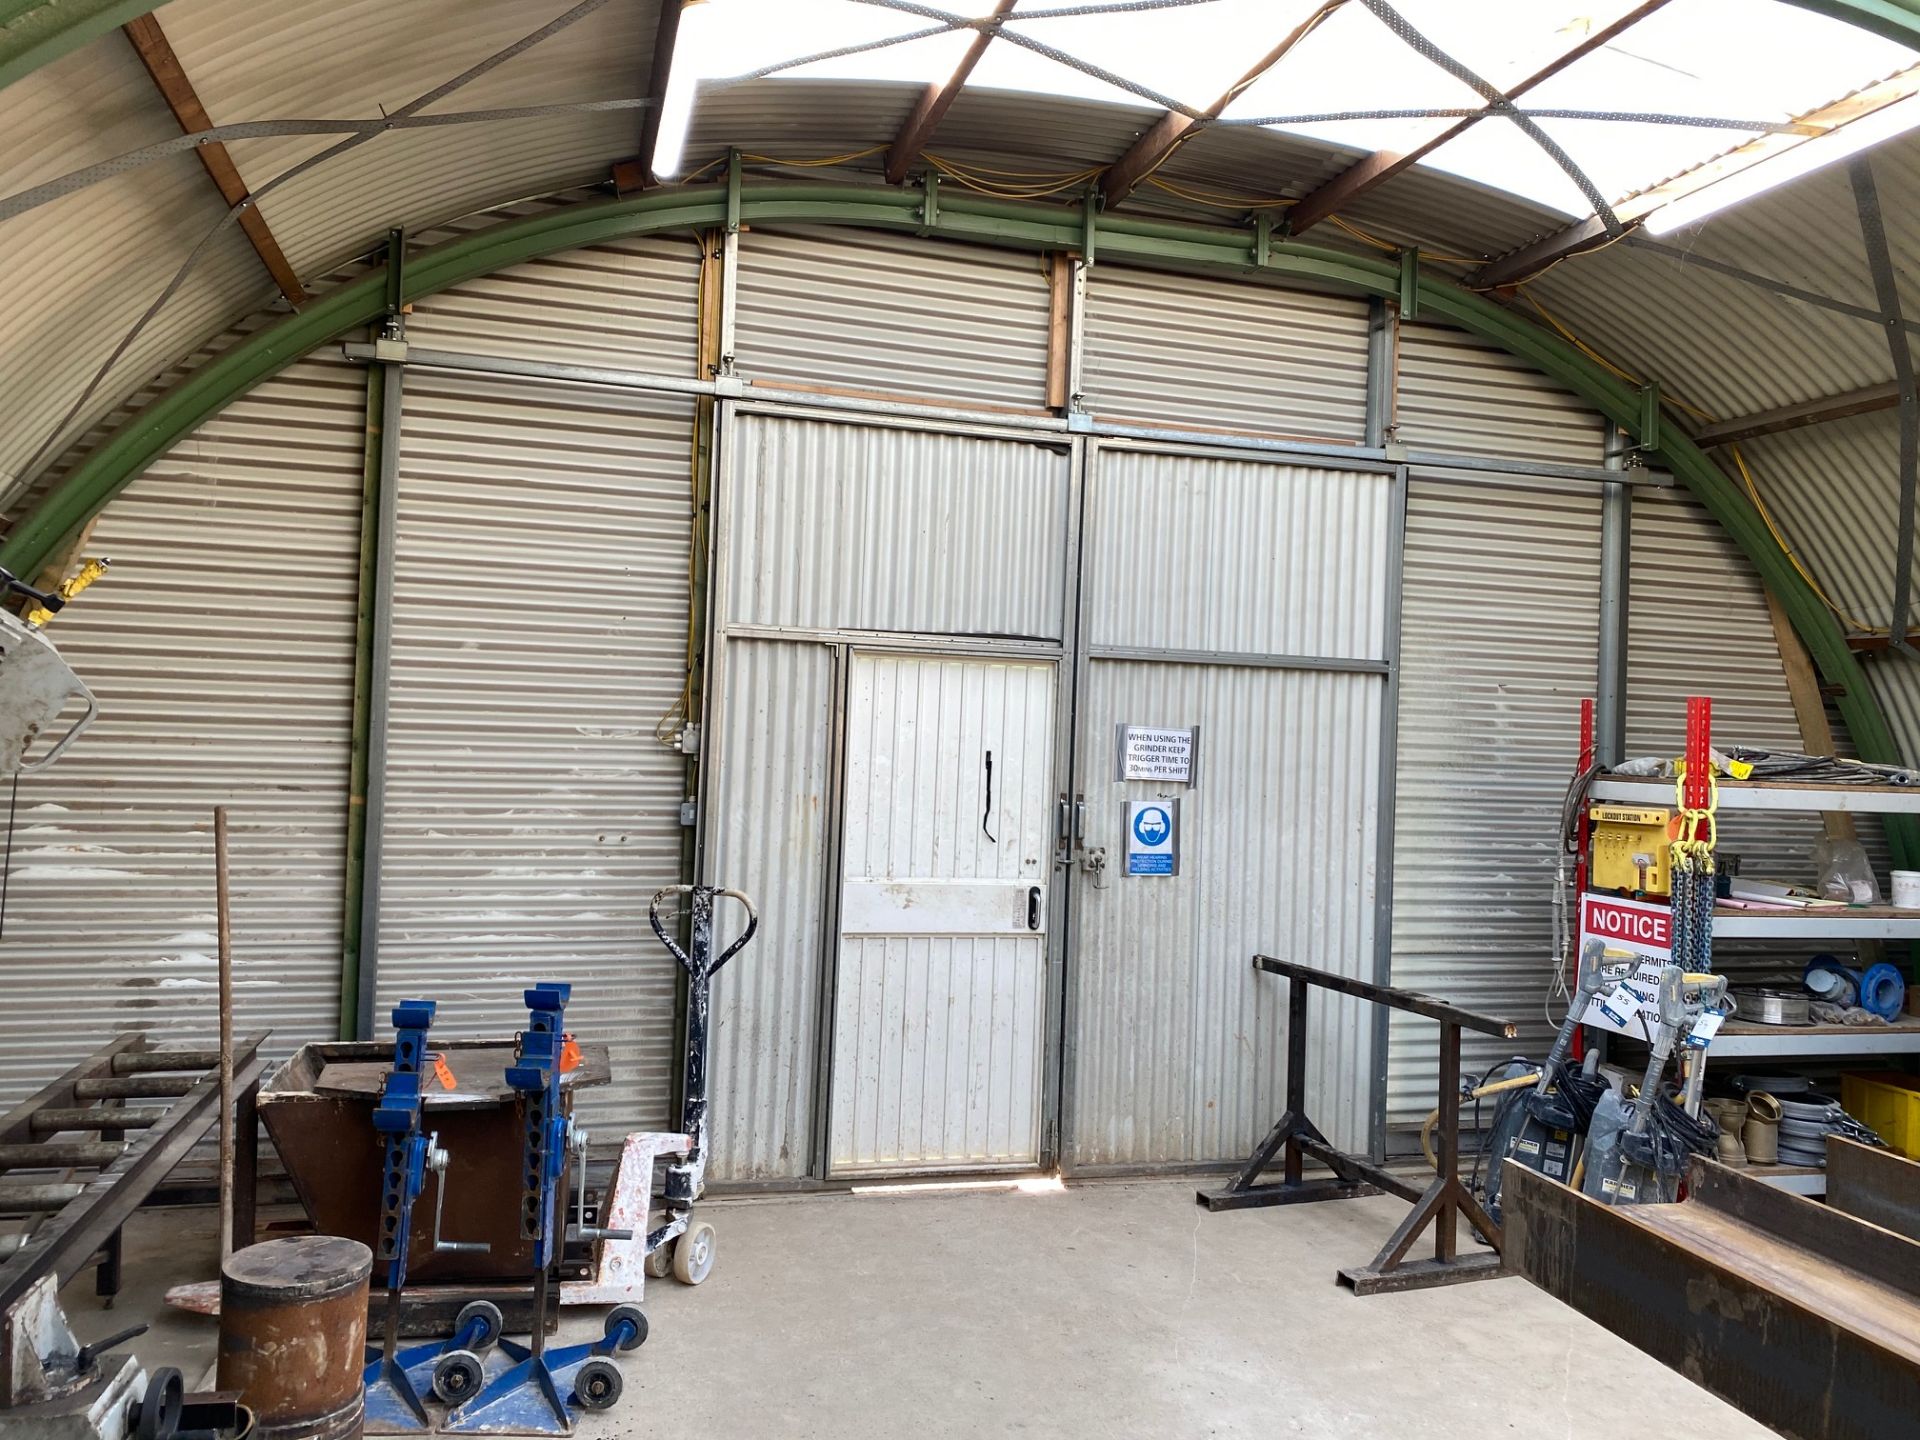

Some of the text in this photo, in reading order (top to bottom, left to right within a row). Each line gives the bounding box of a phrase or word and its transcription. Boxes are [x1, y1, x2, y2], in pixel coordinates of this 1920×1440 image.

[1128, 733, 1191, 744] WHEN USING THE
[1133, 743, 1186, 754] GRINDER KEEP
[1128, 753, 1190, 765] TRIGGER TIME TO
[1154, 765, 1167, 773] PER
[1168, 766, 1188, 775] SHIFT
[1601, 812, 1641, 822] LOCKOUT STATION
[1593, 907, 1667, 942] NOTICE
[1614, 967, 1660, 985] REUIRED
